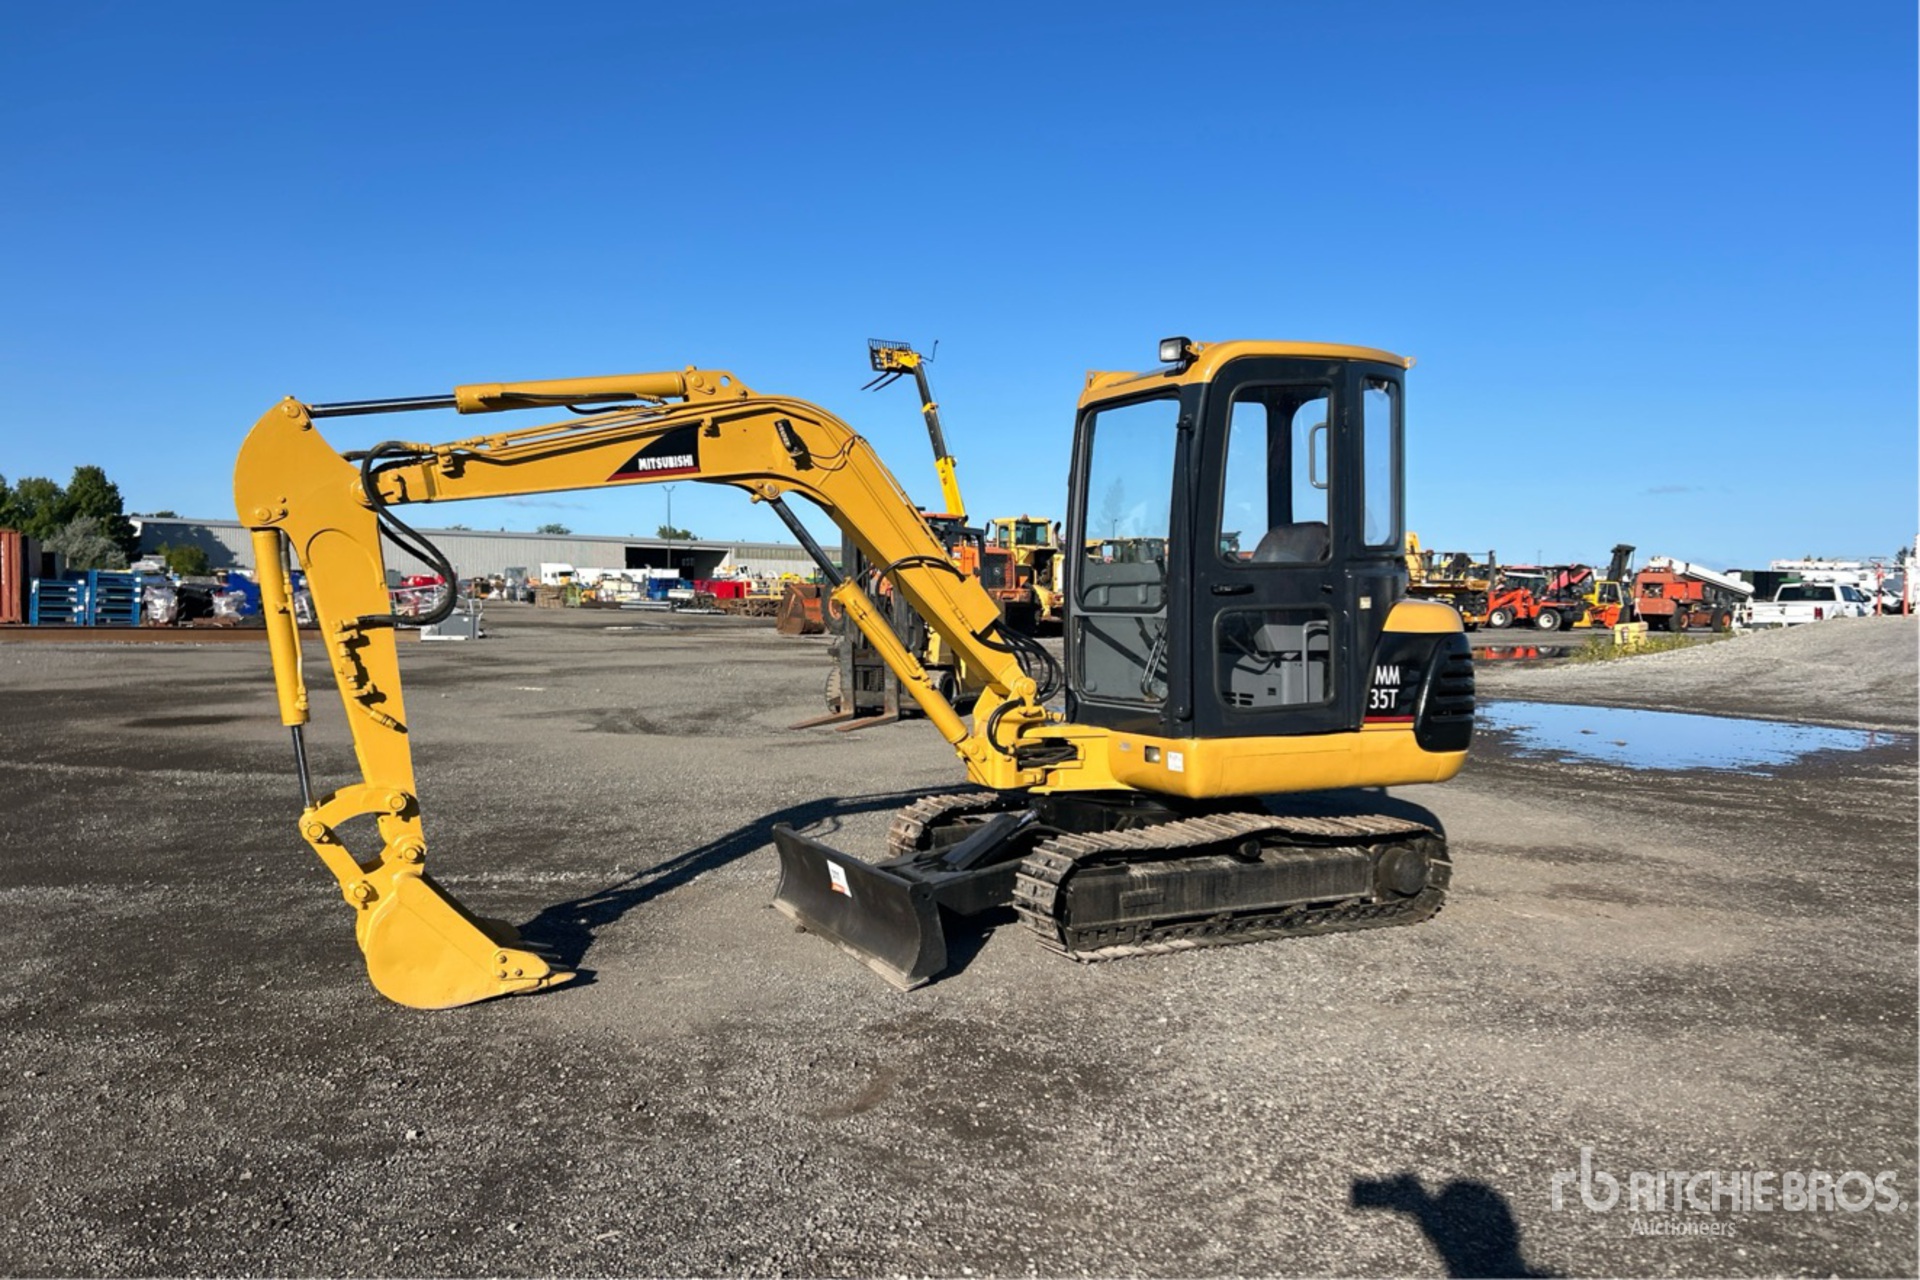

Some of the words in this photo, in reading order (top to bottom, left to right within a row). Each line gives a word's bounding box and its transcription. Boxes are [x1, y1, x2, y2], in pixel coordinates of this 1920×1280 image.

[638, 454, 694, 471] MITSUBISHI
[1375, 665, 1400, 685] MM
[1369, 688, 1399, 709] 35T
